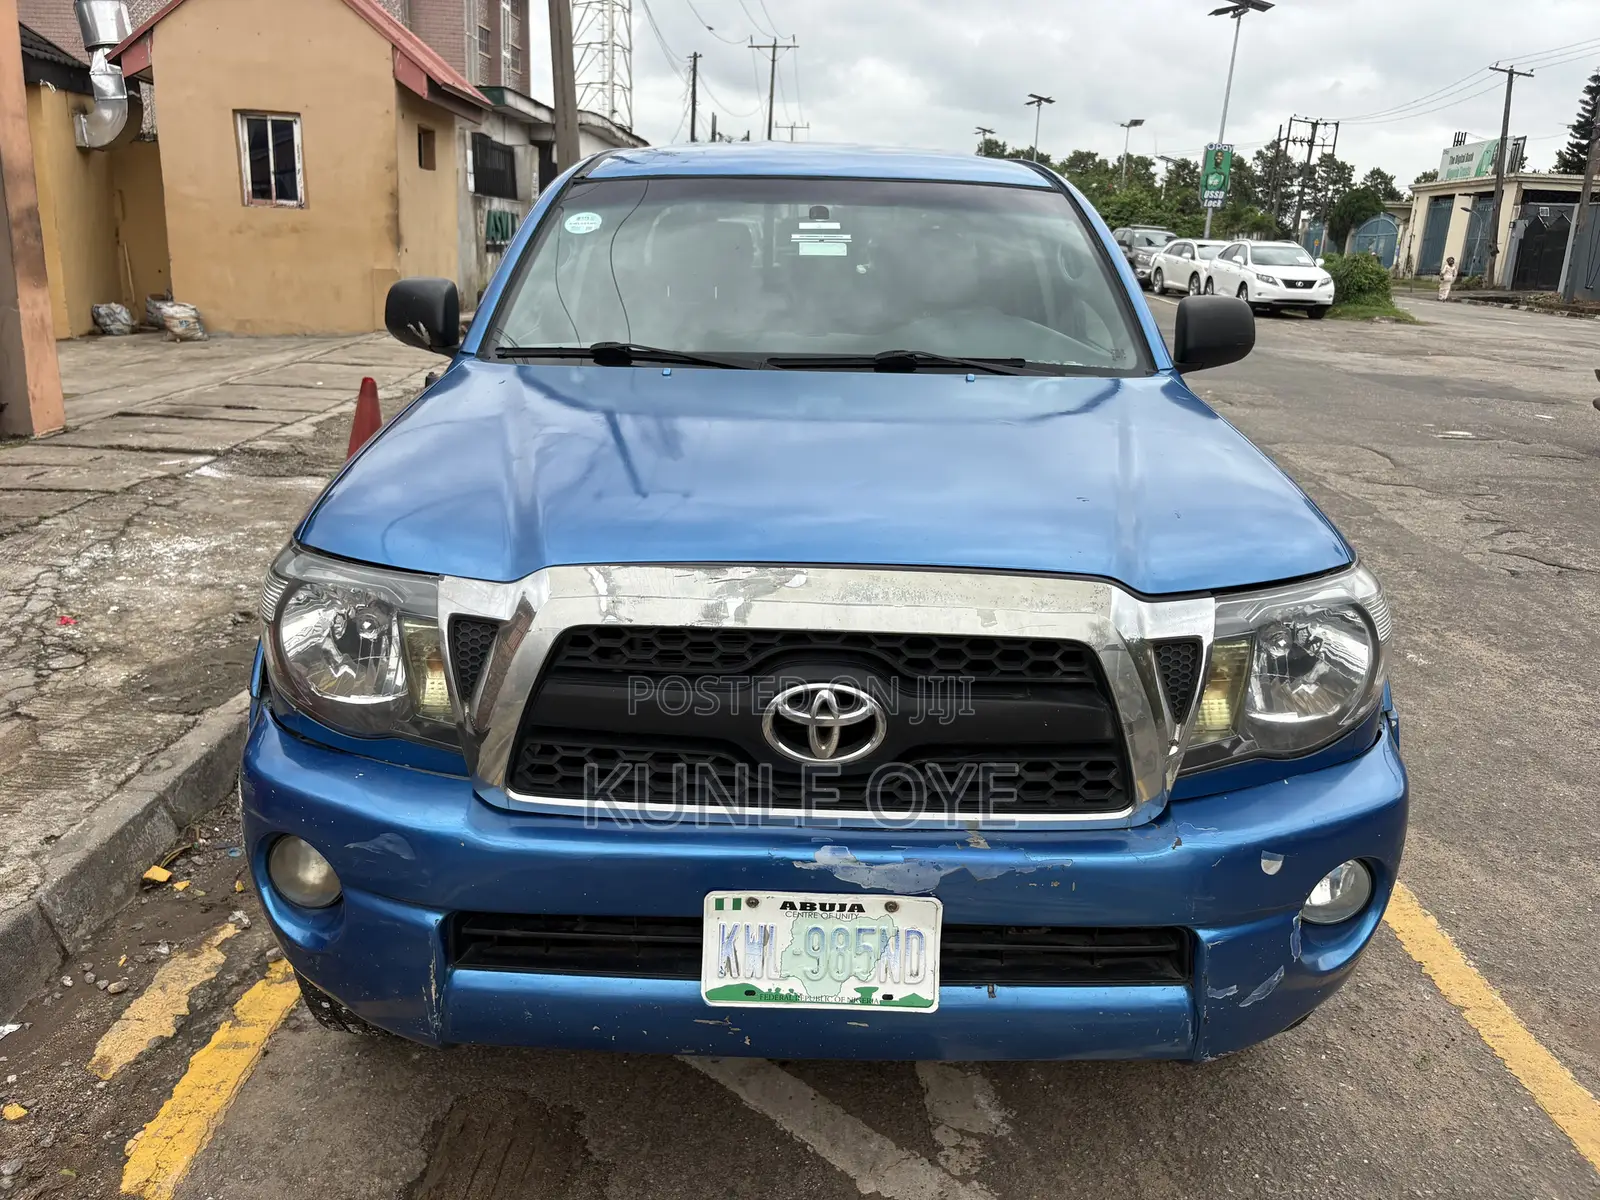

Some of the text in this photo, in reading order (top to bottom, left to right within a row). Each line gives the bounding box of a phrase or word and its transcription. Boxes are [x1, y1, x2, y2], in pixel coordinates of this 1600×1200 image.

[1207, 142, 1233, 152] OPay
[1203, 190, 1225, 199] USSD
[779, 900, 866, 913] ABUJA
[785, 911, 819, 919] CENTRE
[835, 912, 860, 920] UNITY
[759, 993, 789, 1001] FEDERAL
[833, 995, 846, 1003] OF
[847, 996, 881, 1004] NIGERIA
